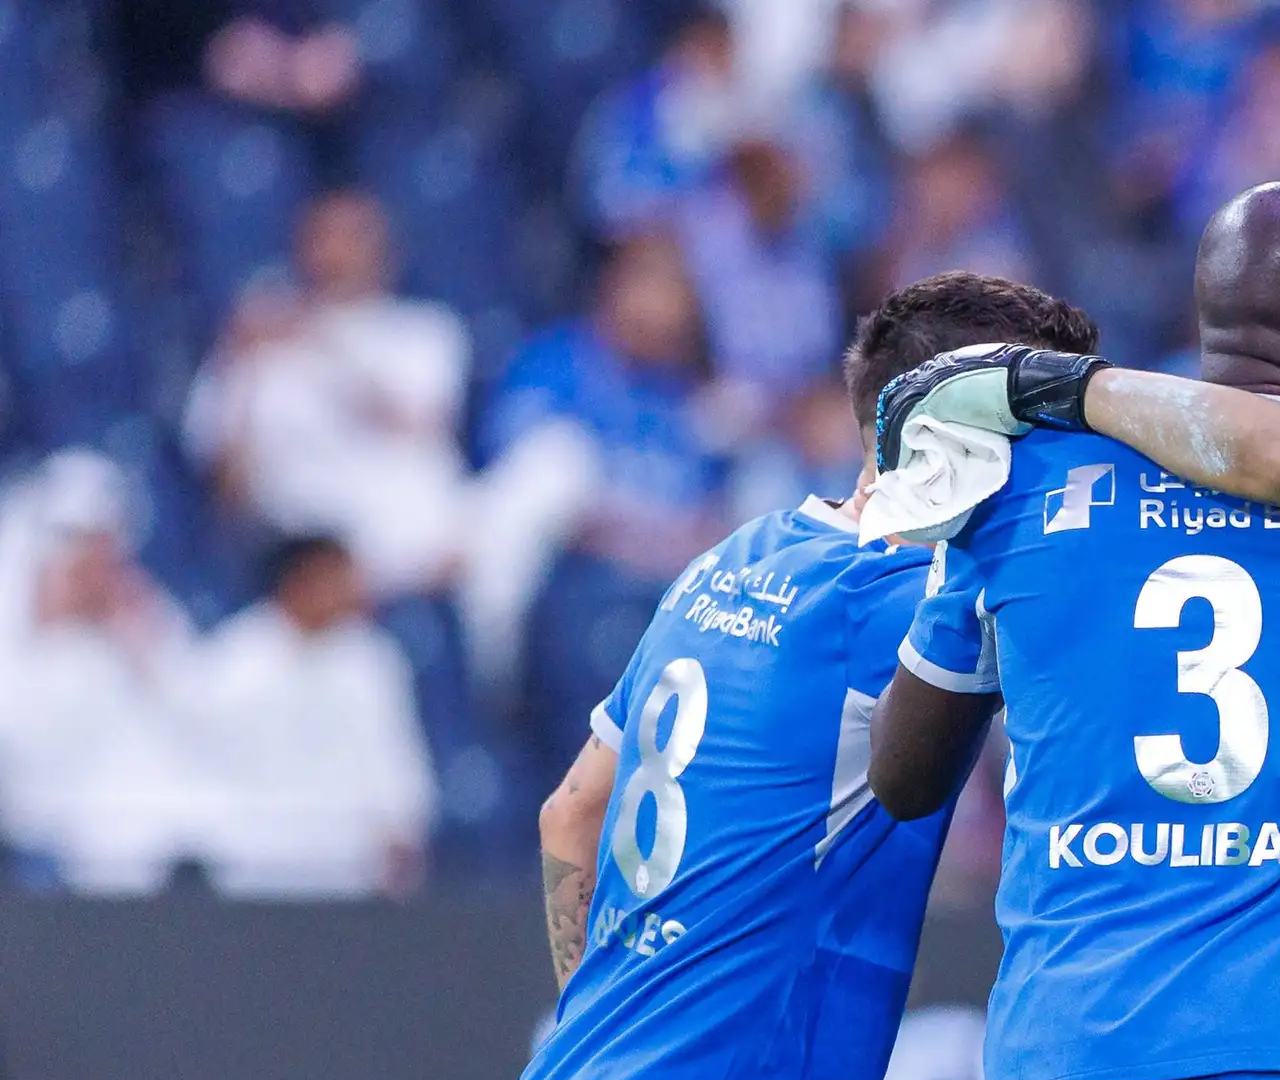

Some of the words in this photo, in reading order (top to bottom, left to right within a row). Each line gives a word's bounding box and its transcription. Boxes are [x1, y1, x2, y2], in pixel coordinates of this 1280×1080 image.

[1139, 499, 1252, 536] Riyad
[612, 658, 707, 900] 8
[1133, 555, 1270, 804] 3
